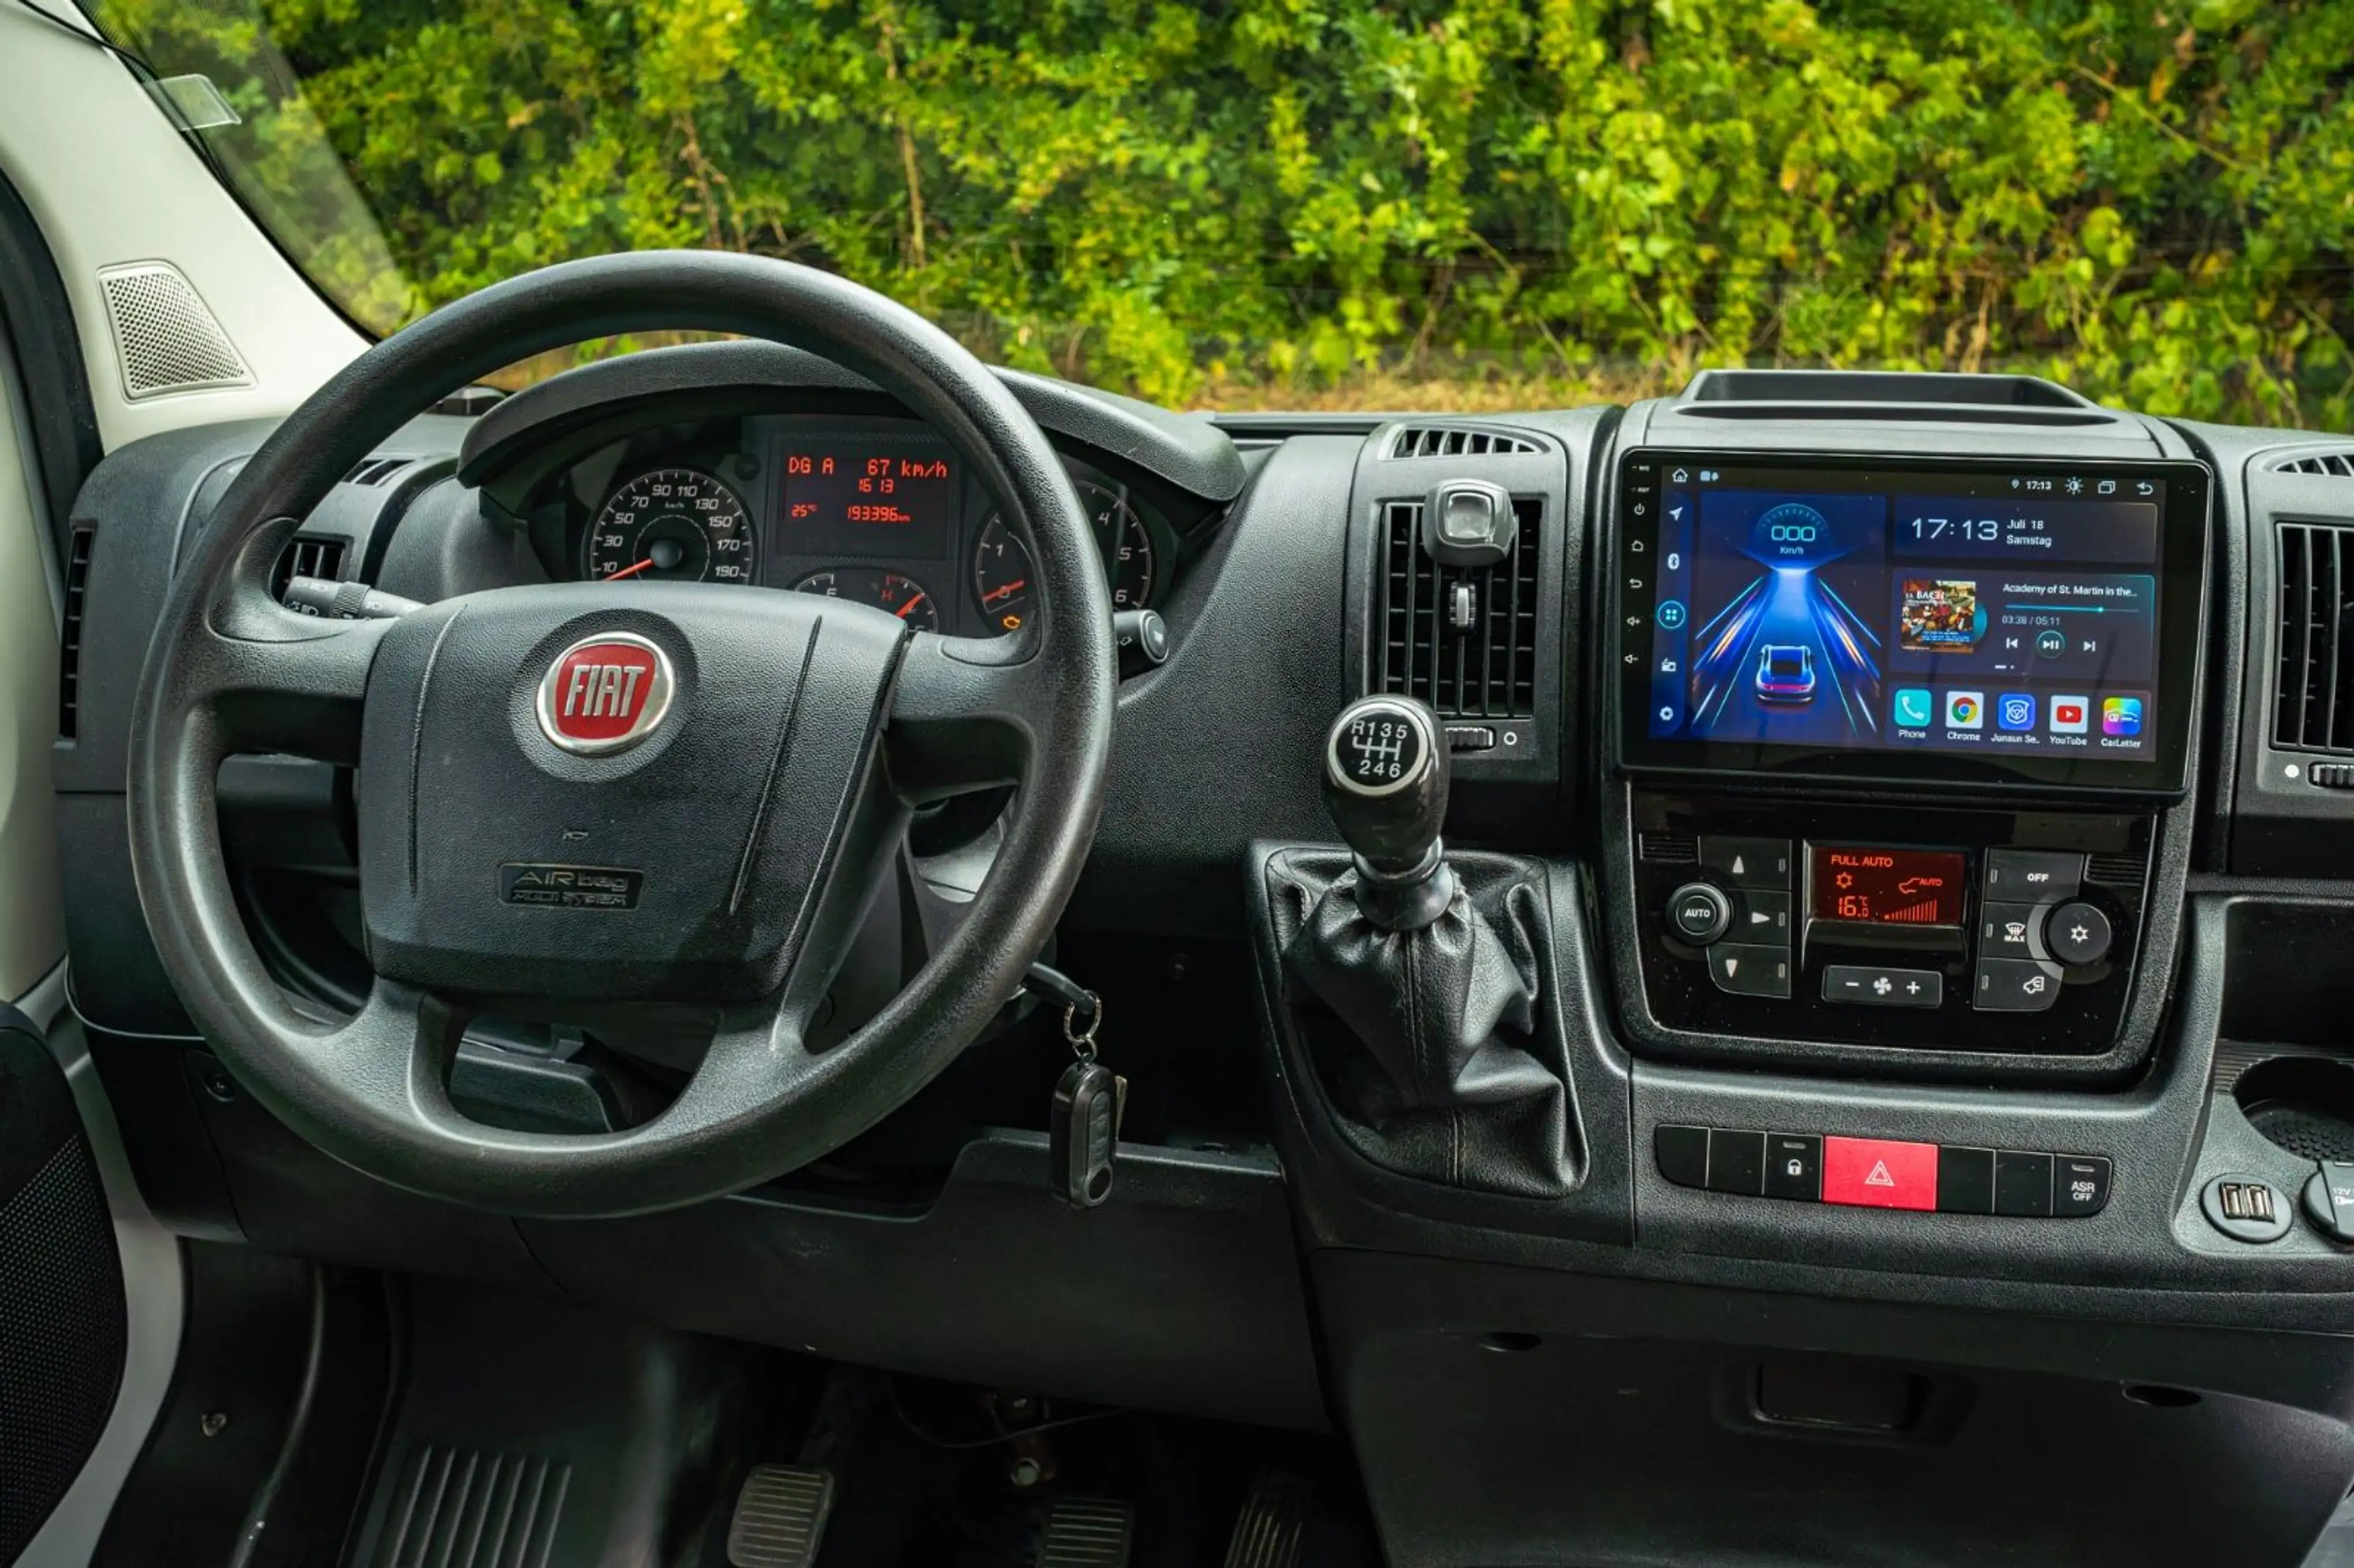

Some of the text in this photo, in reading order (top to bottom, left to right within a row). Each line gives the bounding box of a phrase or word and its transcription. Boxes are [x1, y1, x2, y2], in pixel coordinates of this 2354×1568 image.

[788, 457, 947, 478] DG A 67 km/h
[652, 485, 671, 497] 90
[2025, 481, 2052, 490] 17:13
[678, 486, 698, 497] 110
[630, 497, 650, 508] 70
[694, 498, 719, 510] 130
[614, 513, 634, 524] 50
[708, 516, 733, 528] 150
[1099, 512, 1111, 525] 4
[1911, 518, 1998, 541] 17:13
[2006, 520, 2044, 530] Juli 18
[1771, 525, 1816, 542] 000
[603, 535, 623, 547] 30
[716, 539, 741, 551] 170
[2006, 535, 2052, 547] Samstag
[995, 544, 1004, 557] 1
[1118, 547, 1131, 560] 5
[1780, 545, 1804, 555] Km/h
[602, 562, 618, 573] 10
[714, 566, 740, 577] 190
[882, 590, 893, 601] H
[2002, 584, 2046, 596] Academy
[2047, 585, 2057, 593] of
[2059, 585, 2071, 595] St.
[2073, 585, 2103, 595] Martin
[2105, 587, 2115, 596] in
[1114, 590, 1127, 602] 6
[2002, 615, 2027, 625] 03:38
[2035, 616, 2060, 626] 05:11
[565, 664, 647, 717] FIAT
[1899, 729, 1925, 739] Phone
[1947, 731, 1981, 741] Chrome
[2049, 736, 2087, 746] YouTube
[1830, 854, 1894, 867] FULL AUTO
[1919, 878, 1943, 886] AUTO
[2027, 872, 2049, 882] OFF
[1684, 908, 1710, 918] AUTO
[2071, 1181, 2095, 1193] ASR
[2073, 1192, 2092, 1201] OFF
